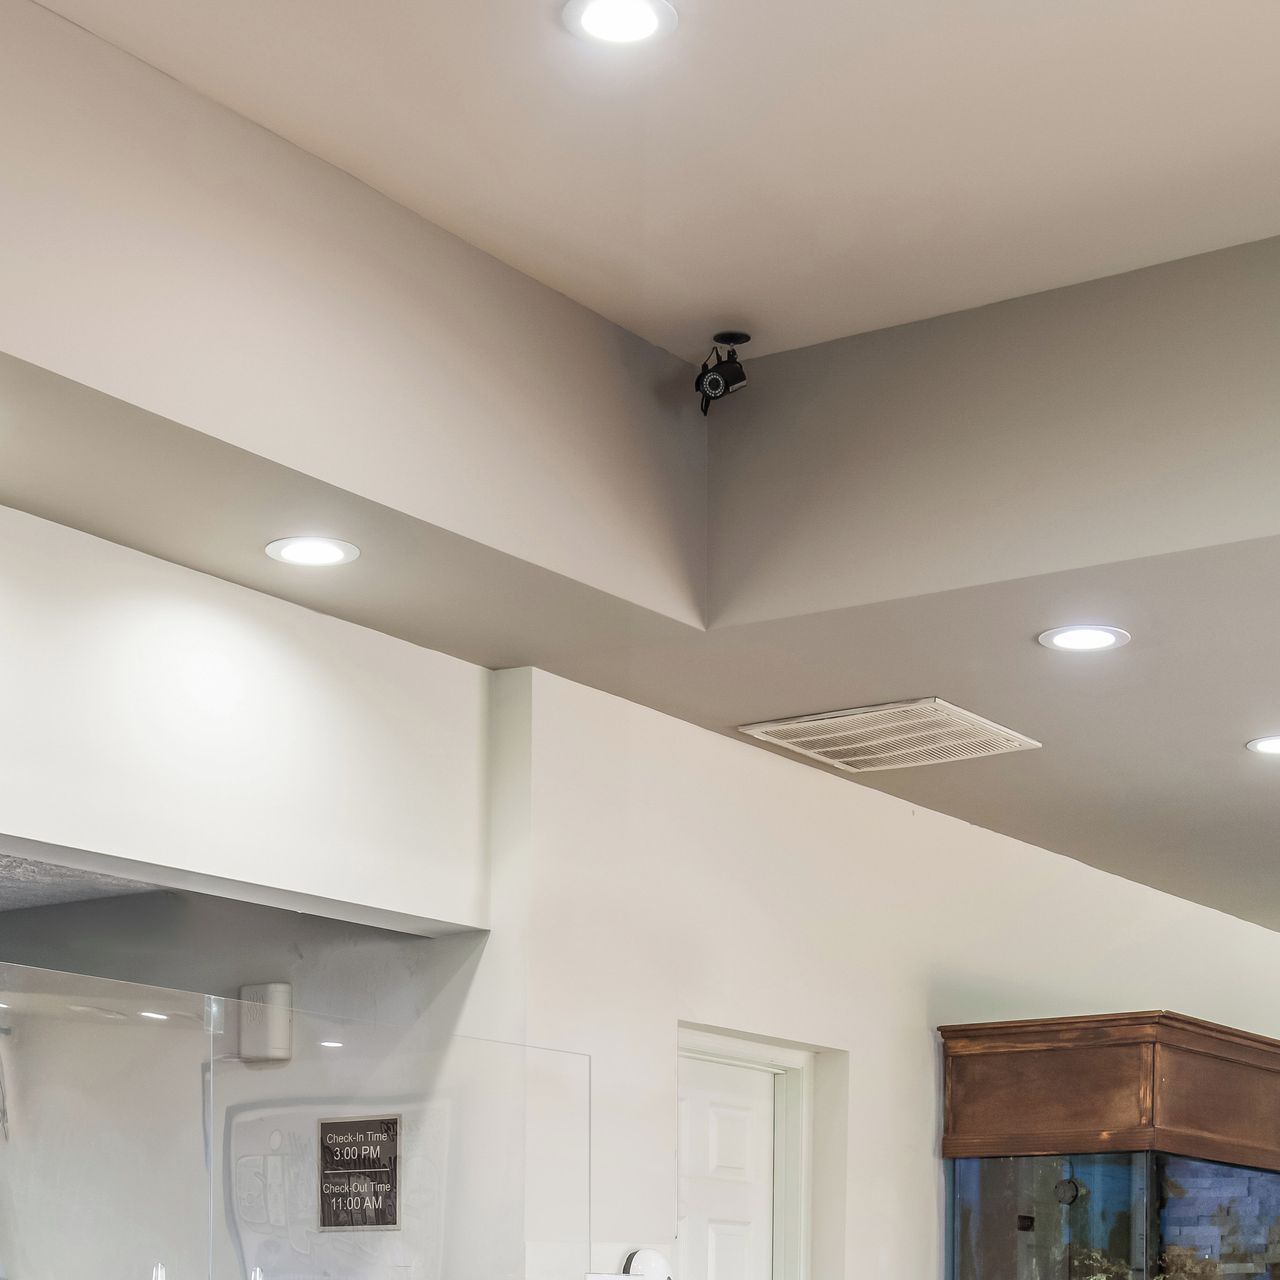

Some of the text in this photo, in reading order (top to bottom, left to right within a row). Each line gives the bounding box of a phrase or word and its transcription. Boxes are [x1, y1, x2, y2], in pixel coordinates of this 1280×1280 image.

[326, 1131, 388, 1144] Check-In Time
[333, 1145, 380, 1160] 3:00 PM
[322, 1181, 391, 1194] Check-Out Time
[331, 1196, 382, 1210] 11:00 AM
